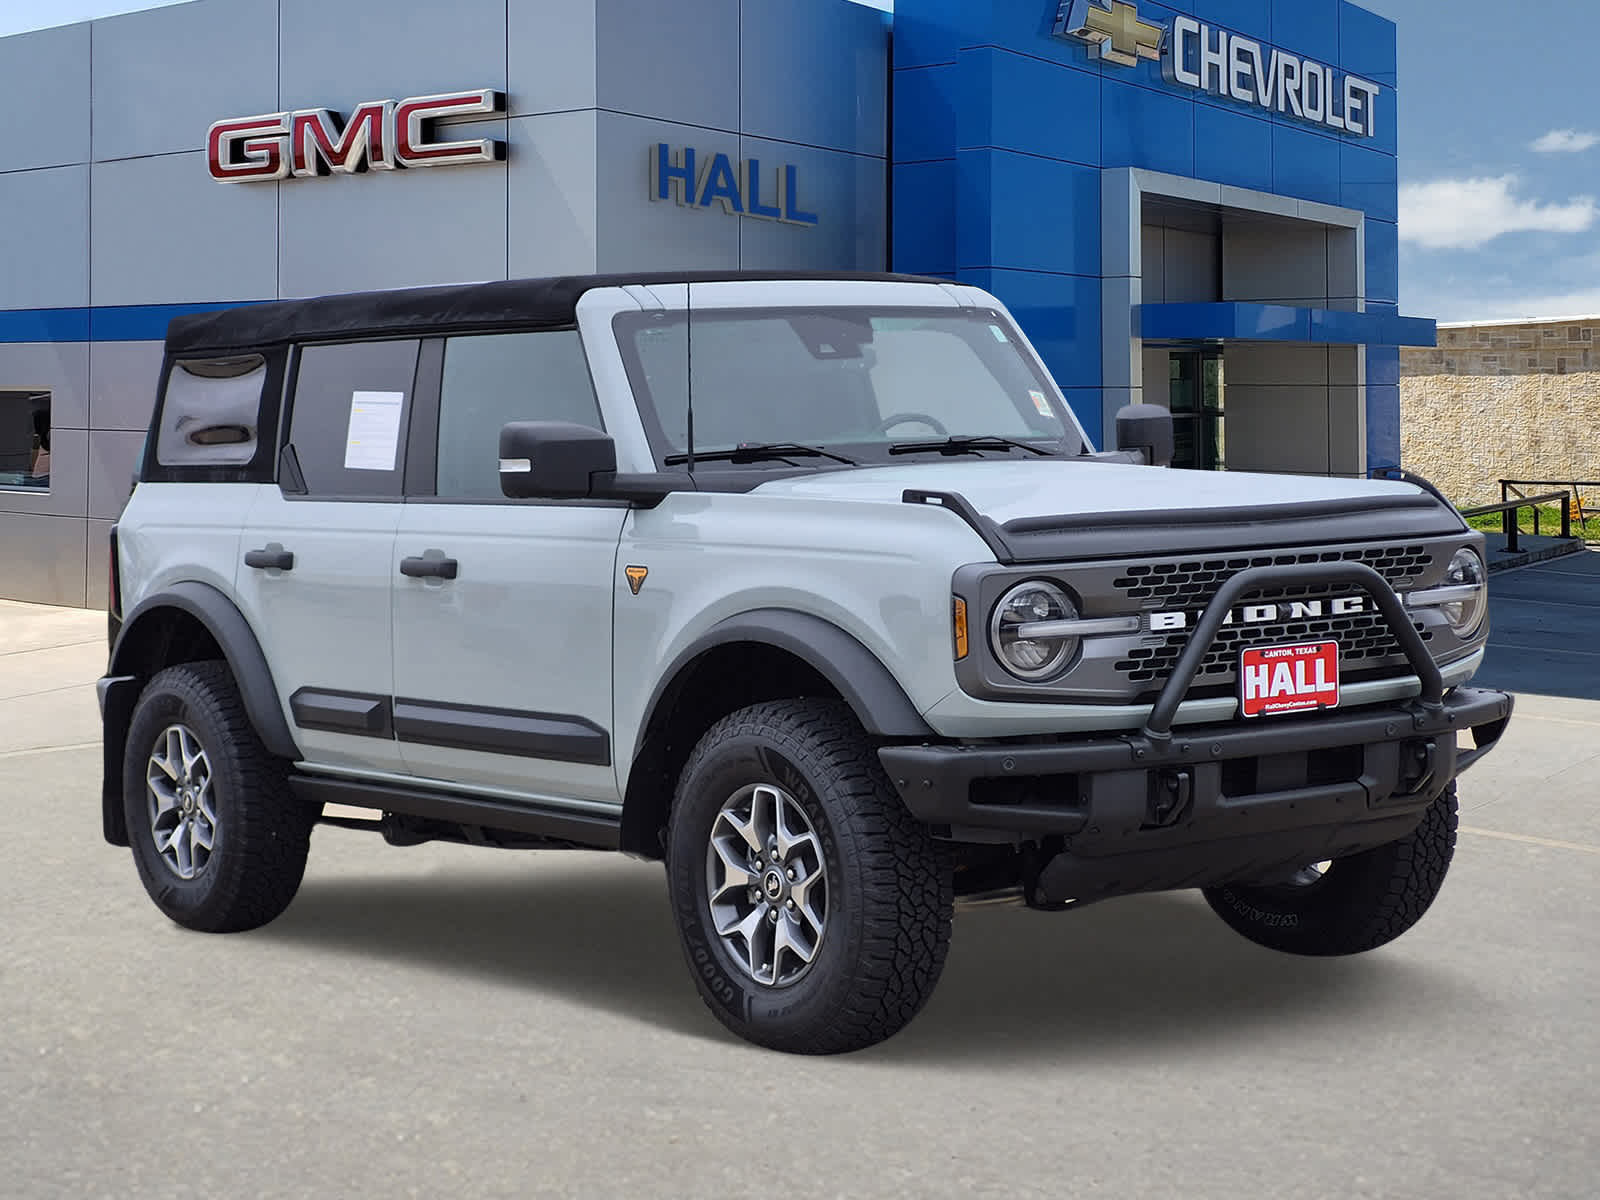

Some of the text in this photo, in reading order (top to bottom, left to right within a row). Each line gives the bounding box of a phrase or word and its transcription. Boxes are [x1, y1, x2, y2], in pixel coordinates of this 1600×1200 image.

[1172, 14, 1380, 137] CHEVROLET
[205, 88, 502, 184] GMC
[653, 142, 819, 226] HALL
[1150, 596, 1379, 631] BONC
[1245, 658, 1336, 700] HALL
[1264, 646, 1318, 659] CANTON, TEXAS
